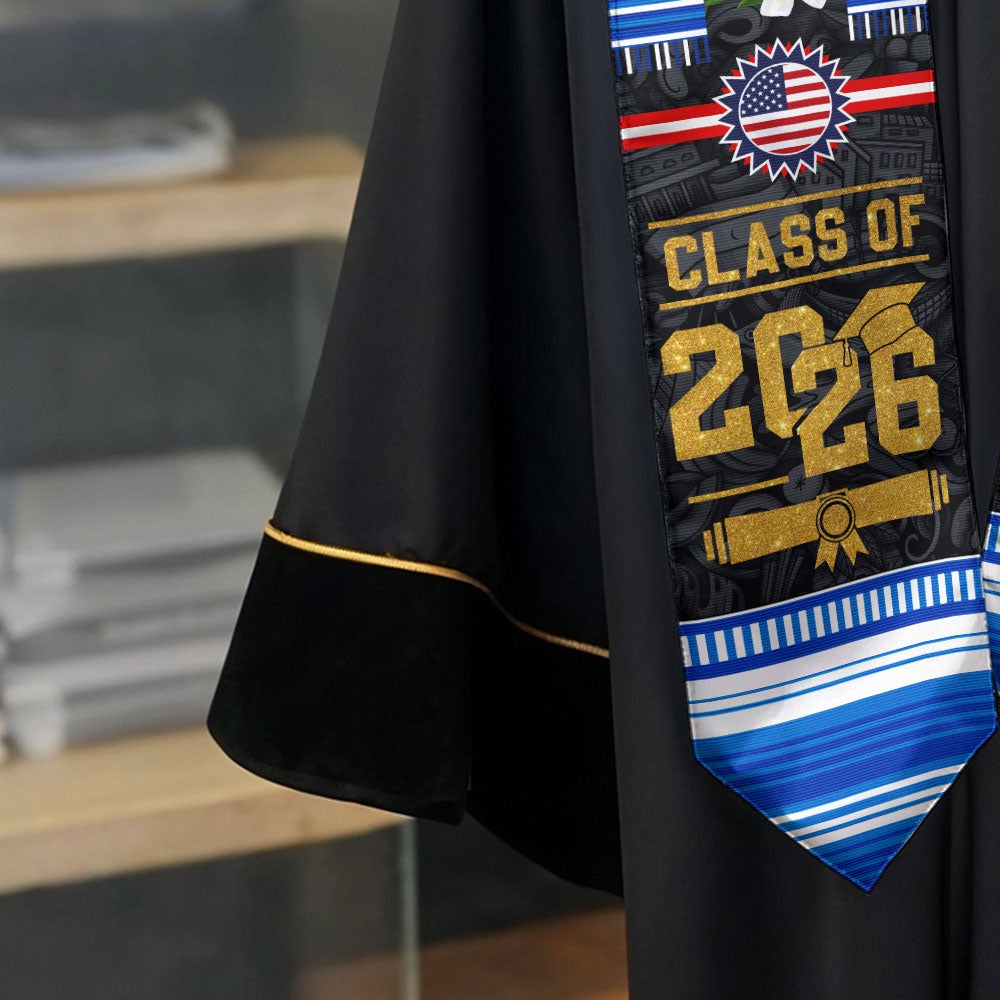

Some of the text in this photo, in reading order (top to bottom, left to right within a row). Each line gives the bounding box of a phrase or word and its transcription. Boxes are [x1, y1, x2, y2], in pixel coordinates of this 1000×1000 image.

[663, 194, 925, 291] CLASS OF
[660, 304, 941, 478] 2026
